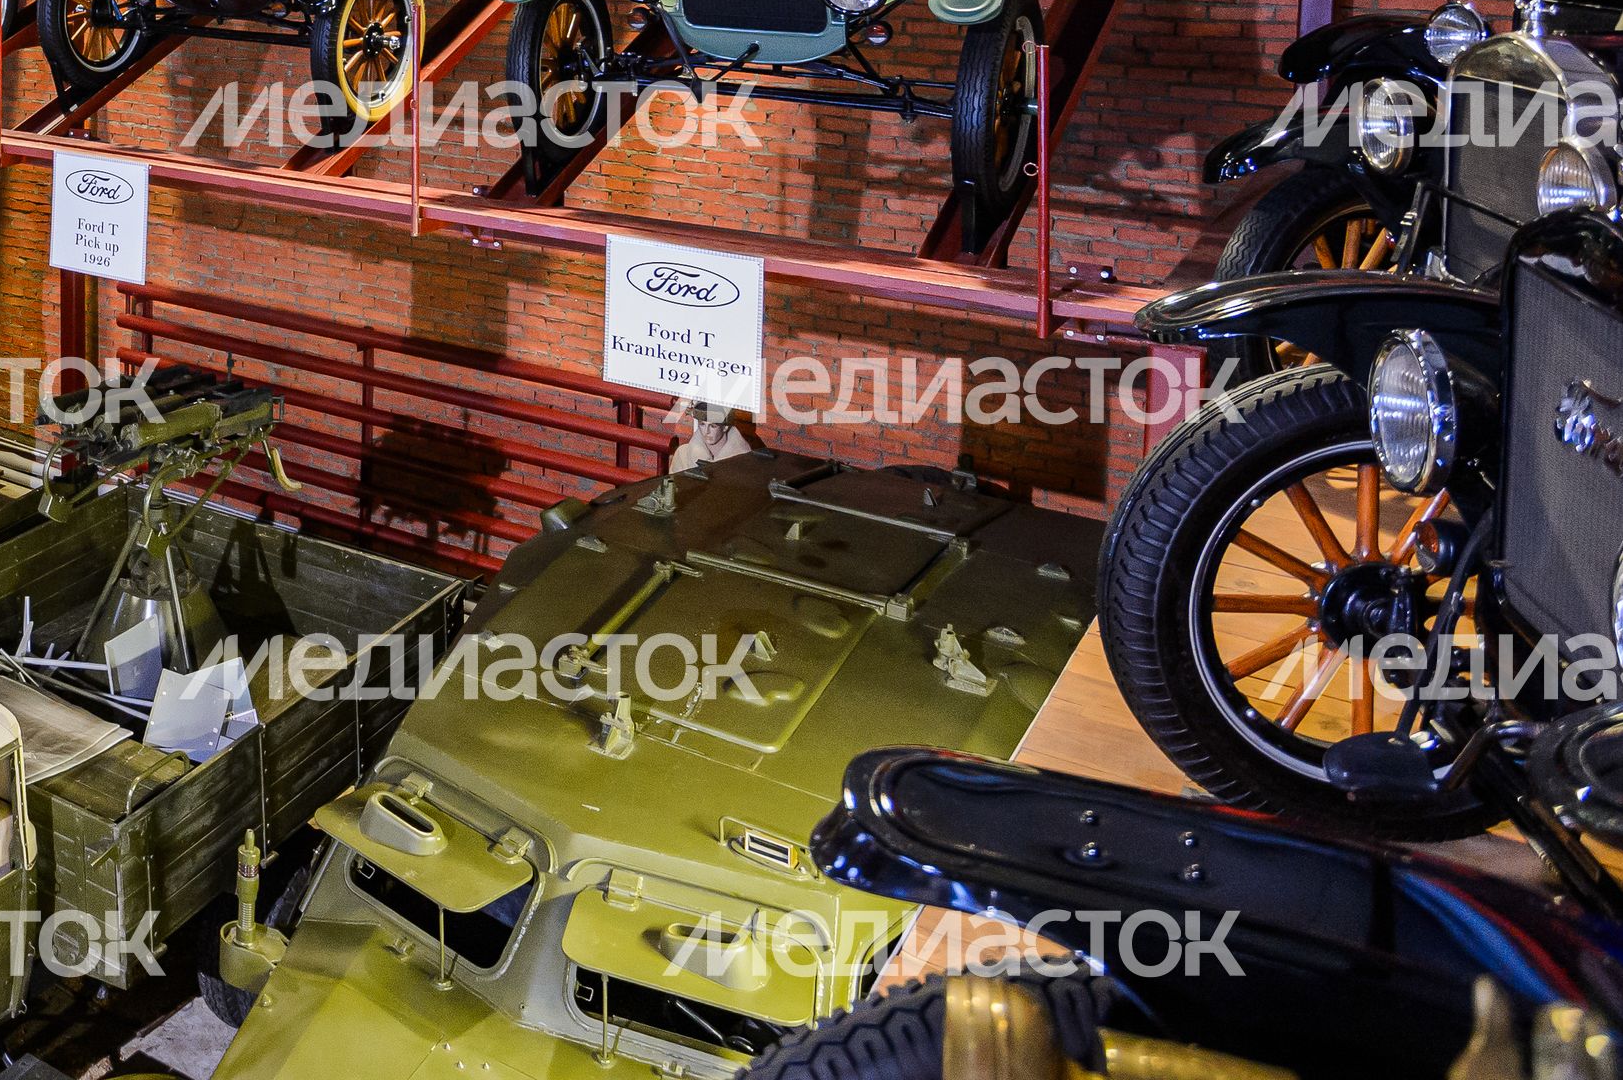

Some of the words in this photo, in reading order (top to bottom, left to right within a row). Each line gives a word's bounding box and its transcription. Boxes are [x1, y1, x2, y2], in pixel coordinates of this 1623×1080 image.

[78, 173, 121, 200] Ford
[78, 218, 104, 234] Ford
[108, 223, 119, 236] T
[75, 233, 101, 249] Pick
[105, 242, 119, 256] up
[83, 252, 111, 267] 1926
[646, 266, 719, 302] Ford
[648, 322, 692, 345] Ford
[699, 331, 716, 349] T
[611, 334, 753, 377] Krankenwagen
[659, 367, 701, 387] 1921
